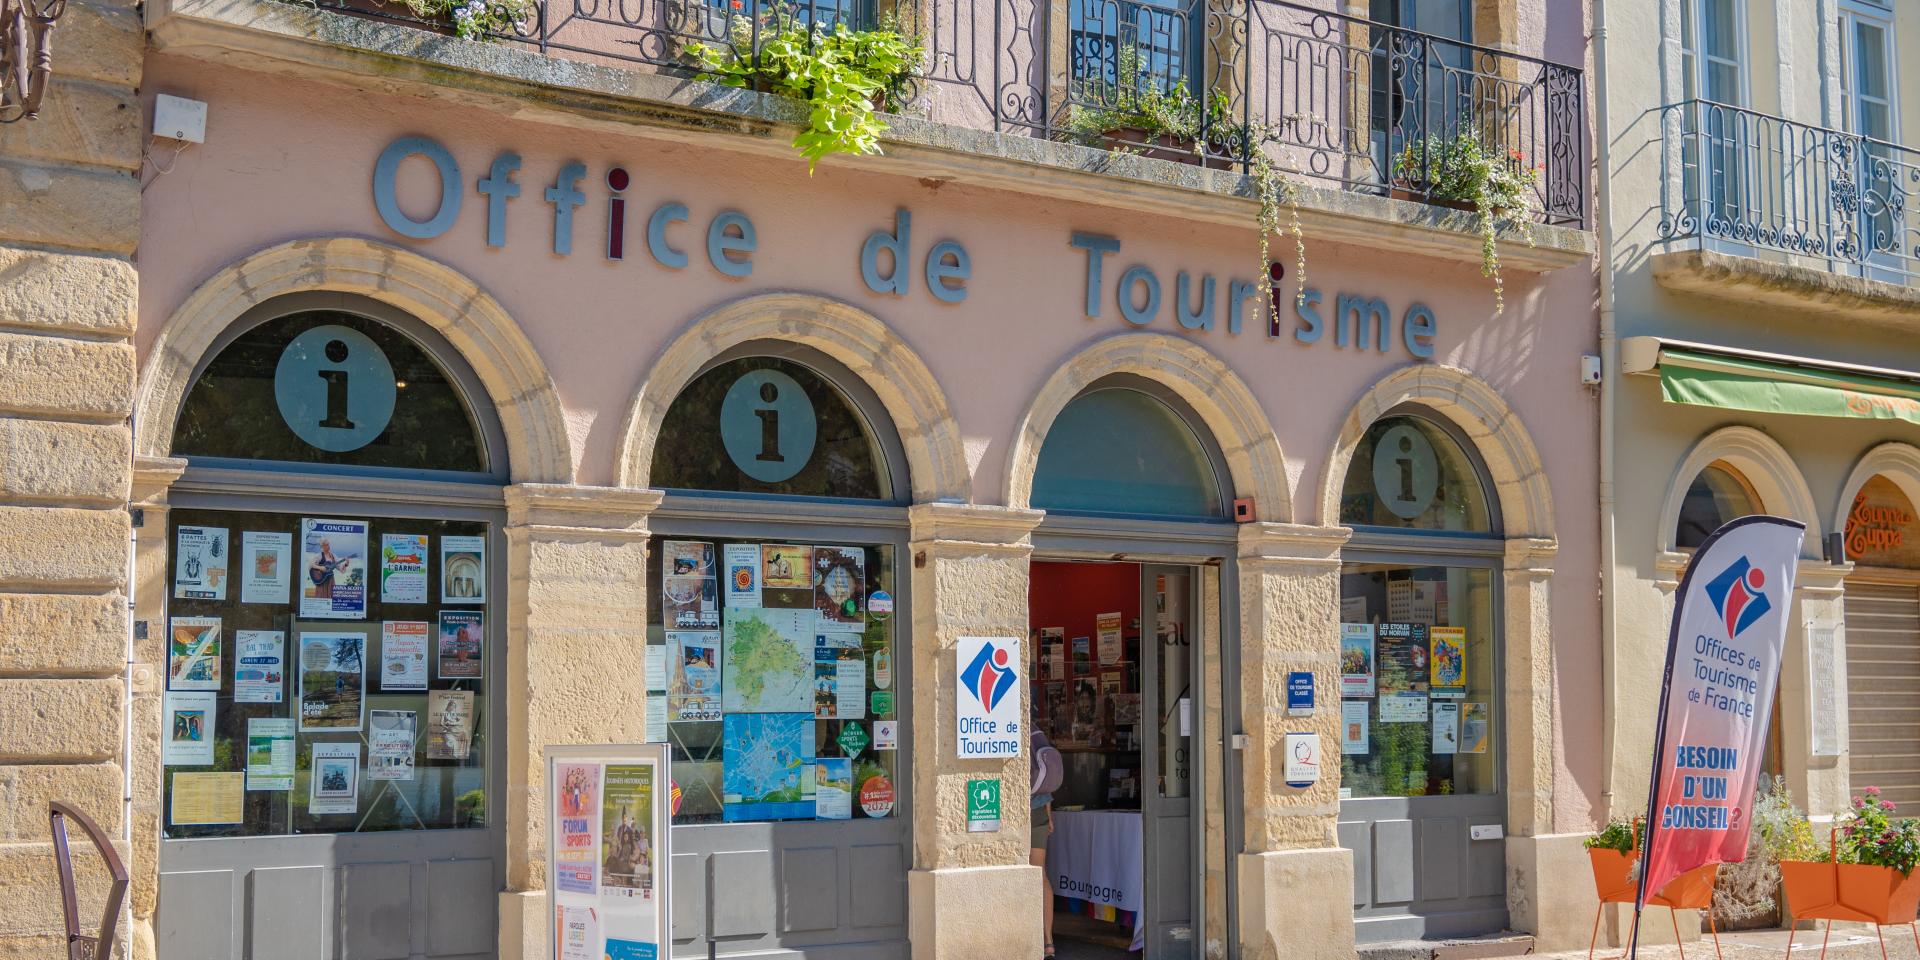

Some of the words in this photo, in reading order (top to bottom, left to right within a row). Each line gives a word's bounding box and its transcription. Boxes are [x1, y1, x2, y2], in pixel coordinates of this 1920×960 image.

[373, 135, 758, 277] Office
[860, 207, 972, 302] de
[1069, 229, 1438, 359] Tourisme
[322, 524, 354, 532] CONCERT
[1695, 634, 1746, 666] Offices
[1748, 656, 1761, 671] de
[1693, 657, 1757, 694] Tourisme
[303, 702, 329, 711] Balade
[1688, 688, 1700, 703] de
[1704, 686, 1753, 718] France
[960, 717, 996, 734] Office
[1006, 720, 1018, 733] de
[960, 737, 1018, 754] Tourisme
[1676, 745, 1738, 770] BESOIN
[1683, 775, 1728, 800] D'UN
[866, 801, 890, 811] 2022
[1661, 805, 1729, 830] CONSEIL
[563, 819, 588, 834] FORUM
[566, 834, 592, 847] SPORTS
[1059, 875, 1124, 902] Bourgogne
